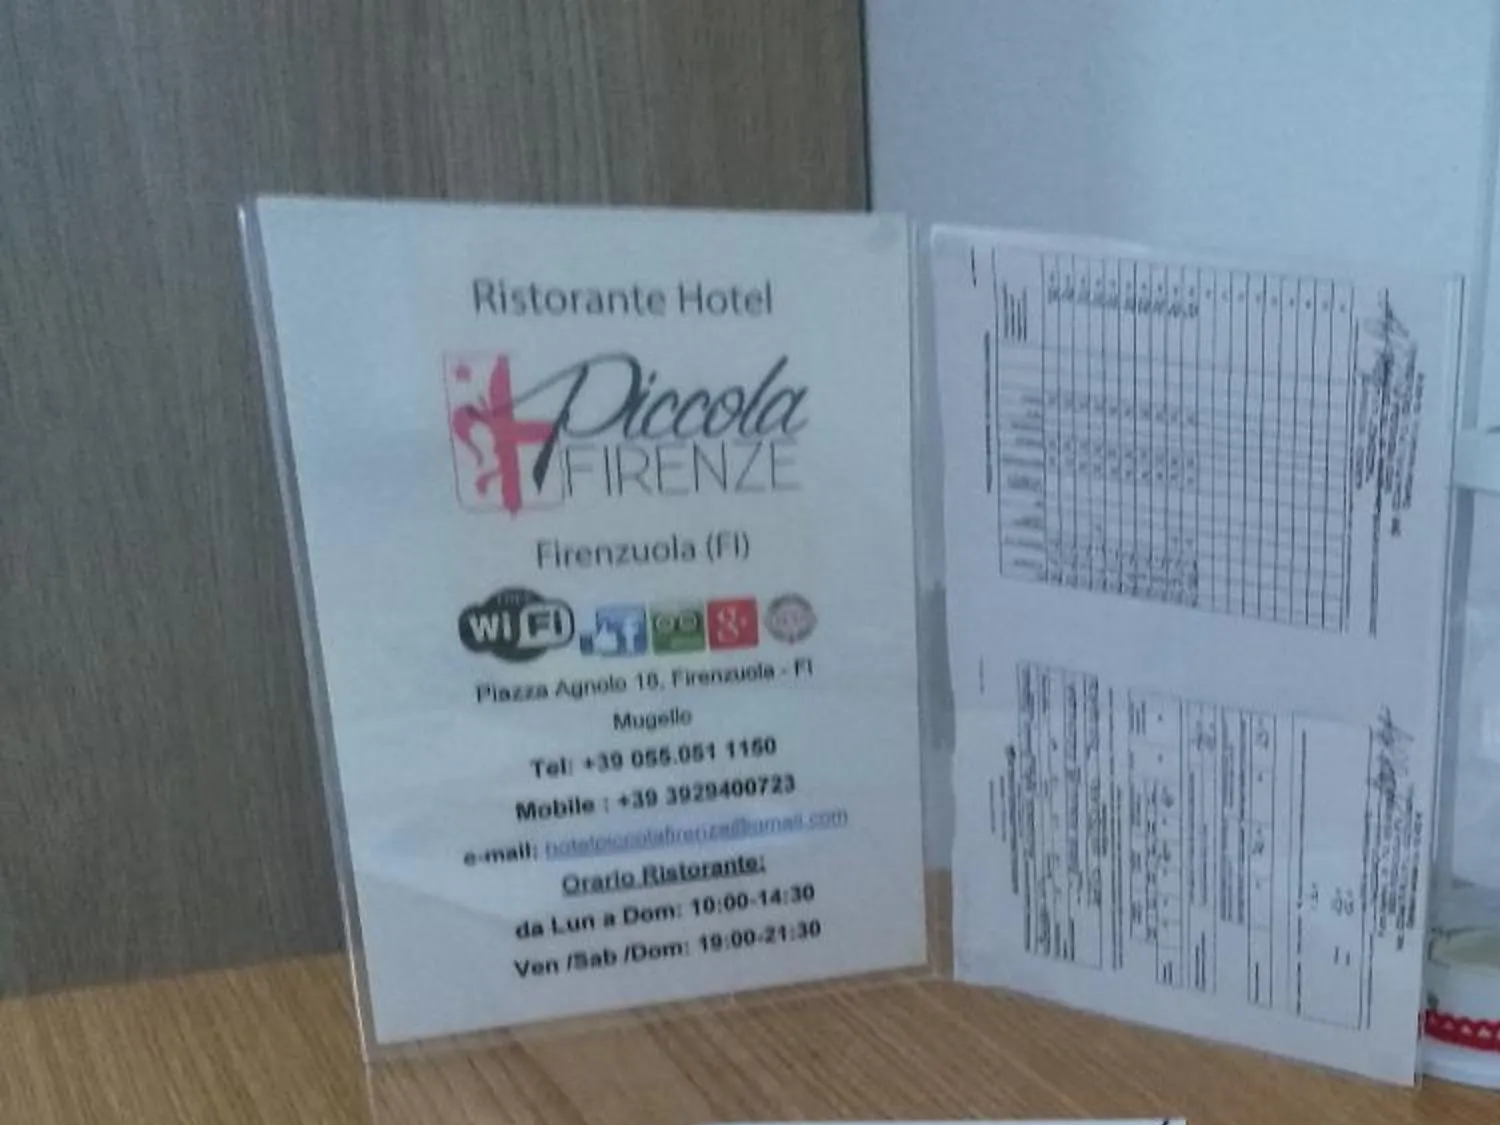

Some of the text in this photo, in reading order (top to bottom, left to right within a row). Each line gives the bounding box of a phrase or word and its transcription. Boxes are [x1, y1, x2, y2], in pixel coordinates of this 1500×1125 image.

[472, 278, 772, 316] Ristorante Hotel
[513, 352, 808, 494] Piccola
[566, 438, 800, 497] FIRENZE
[536, 531, 749, 569] Firenzuola (FI)
[476, 682, 549, 704] Piazza
[555, 677, 627, 700] Agnolo
[672, 664, 775, 688] Firenzuola
[612, 708, 692, 731] Mugello
[530, 757, 574, 780] Tel:
[582, 751, 623, 774] +39
[515, 797, 595, 823] Mobile
[617, 788, 658, 810] +39
[463, 843, 538, 867] e-mail:
[561, 854, 766, 898] Orario Ristorante:
[515, 920, 544, 940] da
[551, 914, 595, 935] Lun
[603, 913, 615, 928] a
[623, 903, 682, 924] Dom:
[513, 956, 559, 979] Ven
